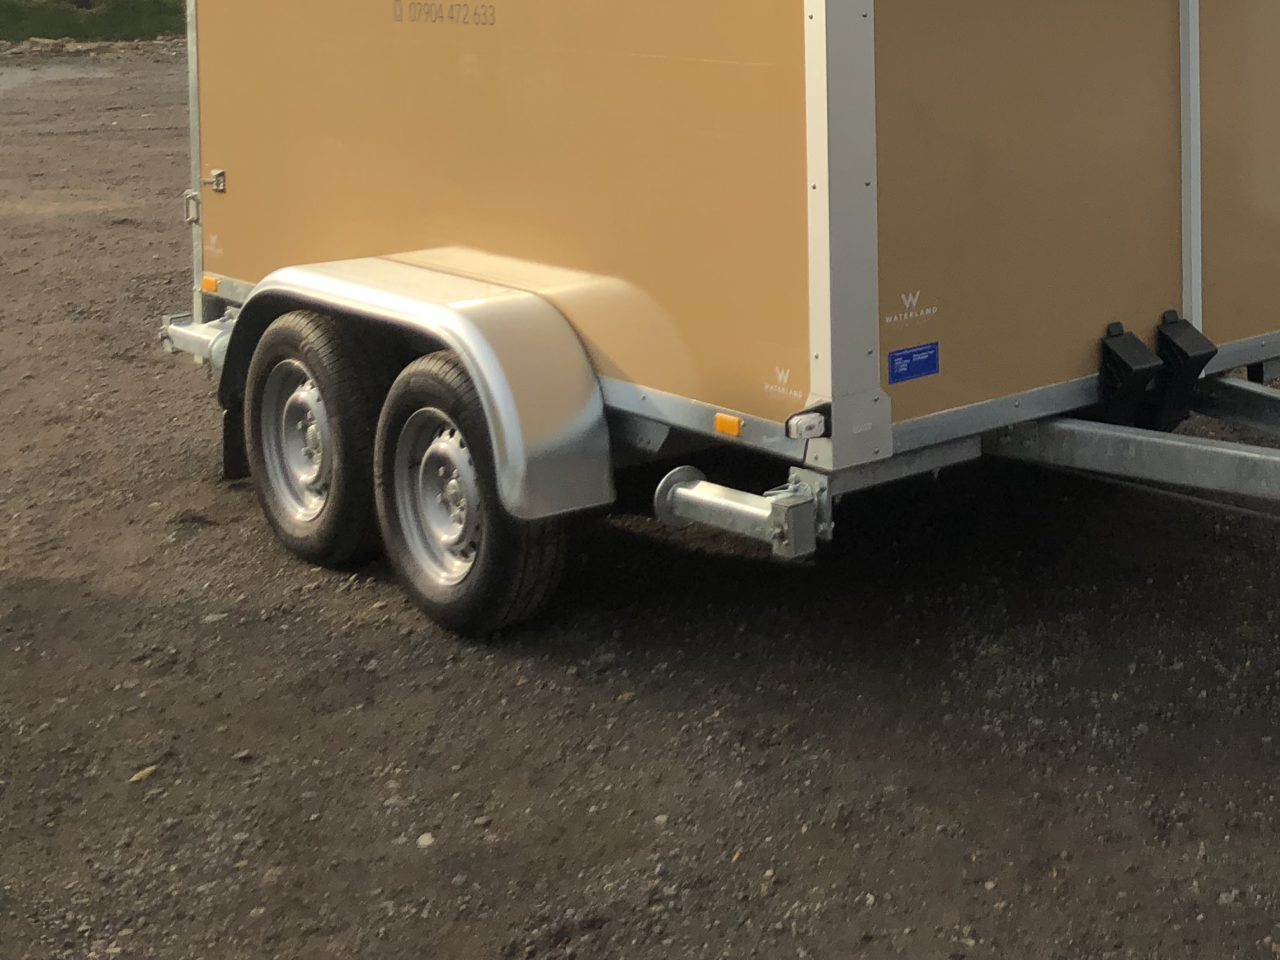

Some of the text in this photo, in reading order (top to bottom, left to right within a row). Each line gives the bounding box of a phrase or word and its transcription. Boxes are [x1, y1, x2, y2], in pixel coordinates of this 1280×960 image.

[408, 1, 496, 26] 07904 472 633
[885, 306, 938, 324] WATERLAND
